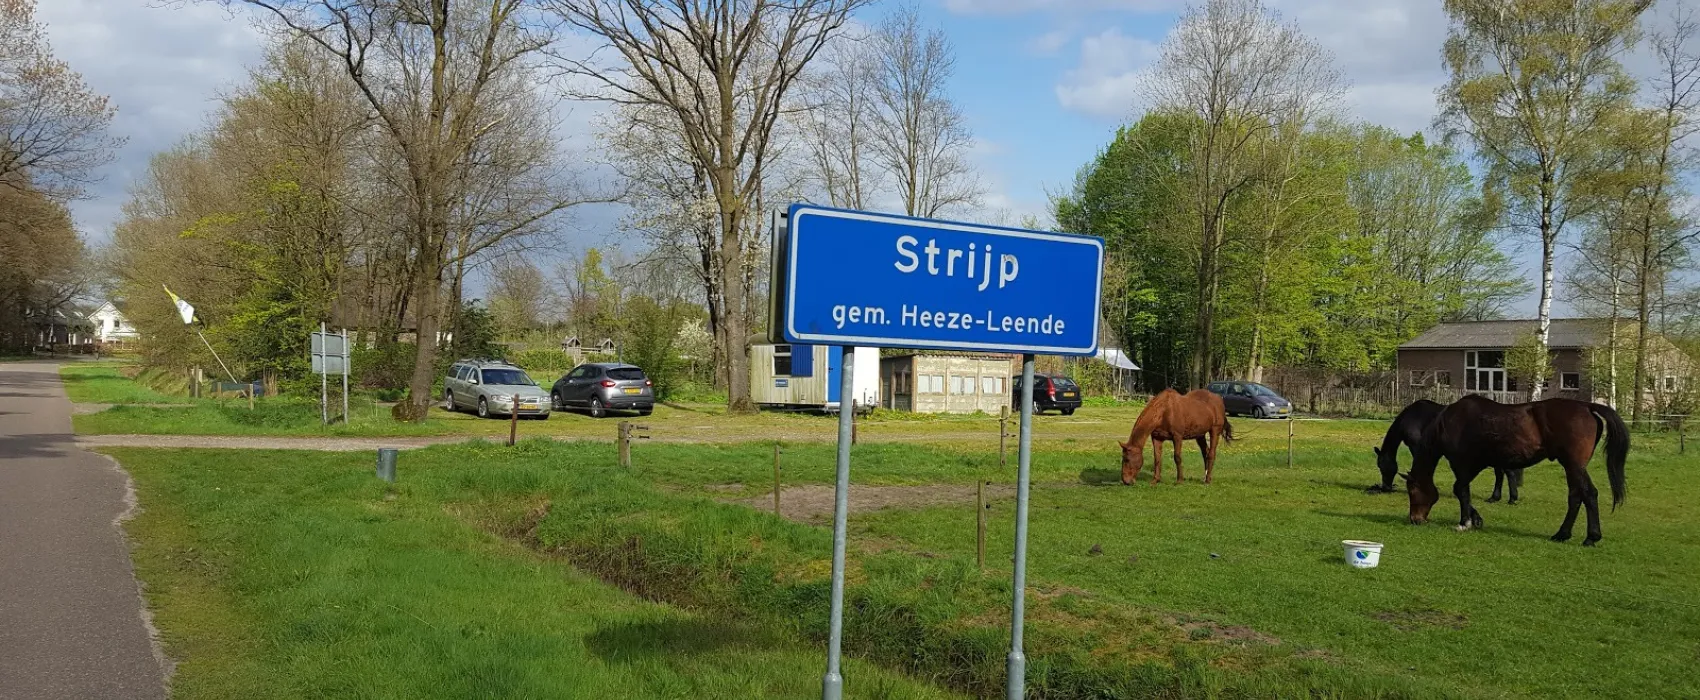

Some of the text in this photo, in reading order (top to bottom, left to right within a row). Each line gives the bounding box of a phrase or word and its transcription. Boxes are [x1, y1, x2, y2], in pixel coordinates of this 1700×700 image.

[894, 235, 1019, 292] Strijp
[832, 304, 1065, 335] gem. Heeze-Leende
